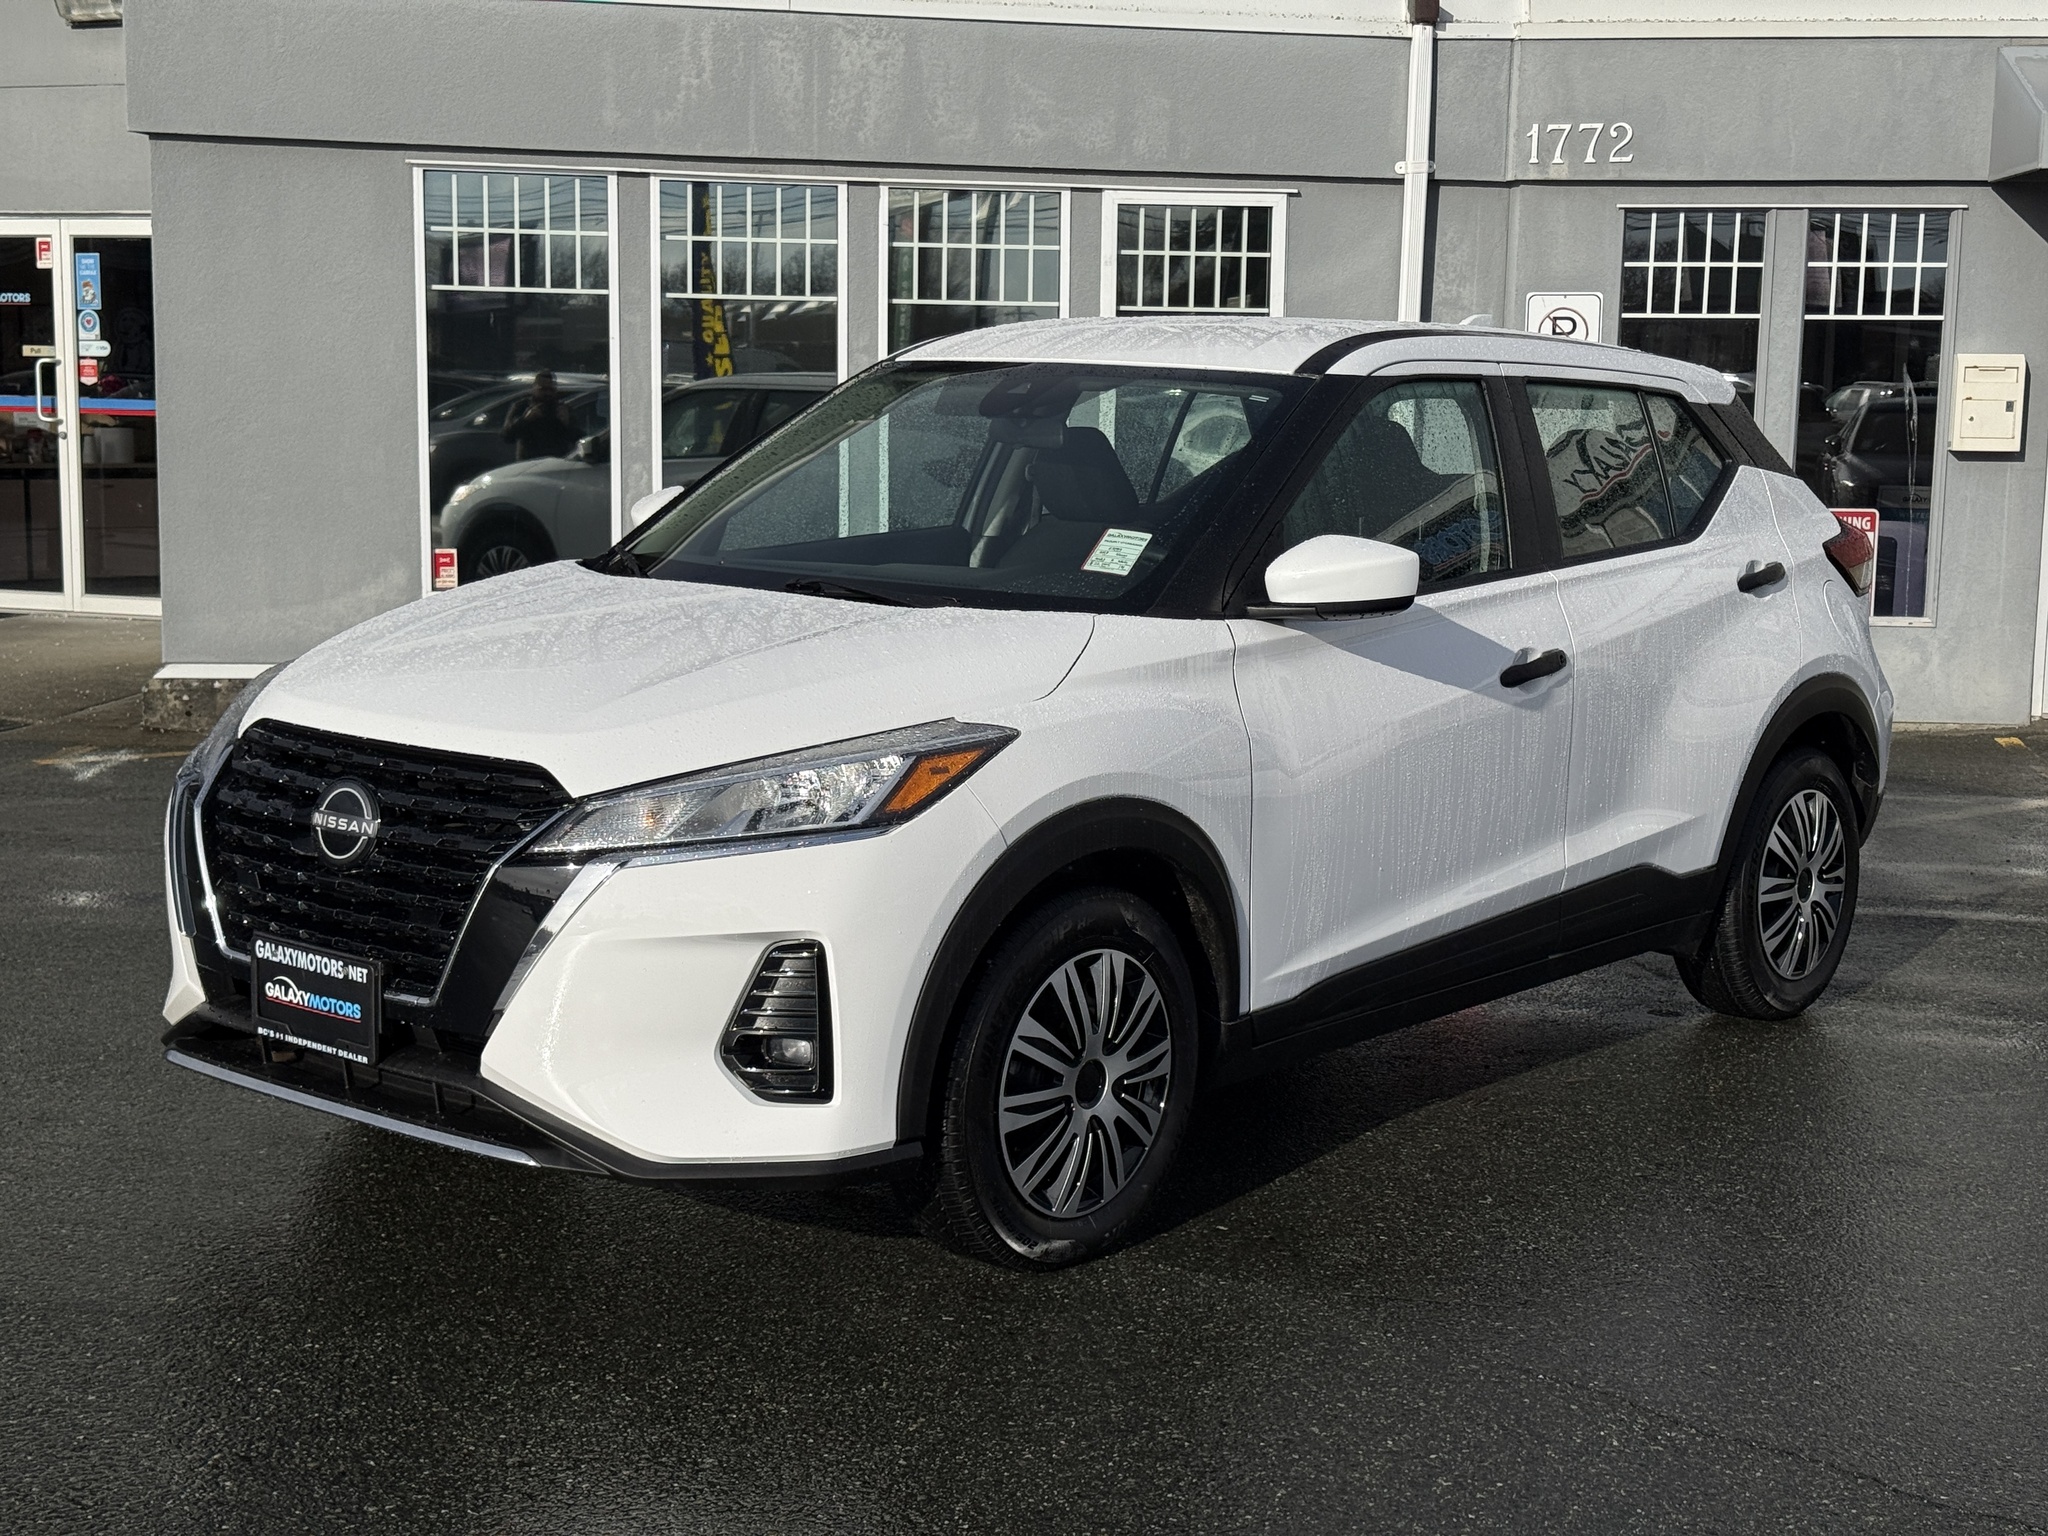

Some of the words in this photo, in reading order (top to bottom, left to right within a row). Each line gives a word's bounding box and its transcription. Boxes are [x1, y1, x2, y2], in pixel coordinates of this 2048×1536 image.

[1526, 122, 1634, 164] 1772
[0, 293, 31, 303] OTORS
[312, 811, 374, 835] NISSAN
[265, 980, 361, 1019] GALAXYMOTORS
[257, 1026, 275, 1038] BC'S
[285, 1034, 338, 1055] INDEPENDENT
[337, 1048, 369, 1065] DEALER
